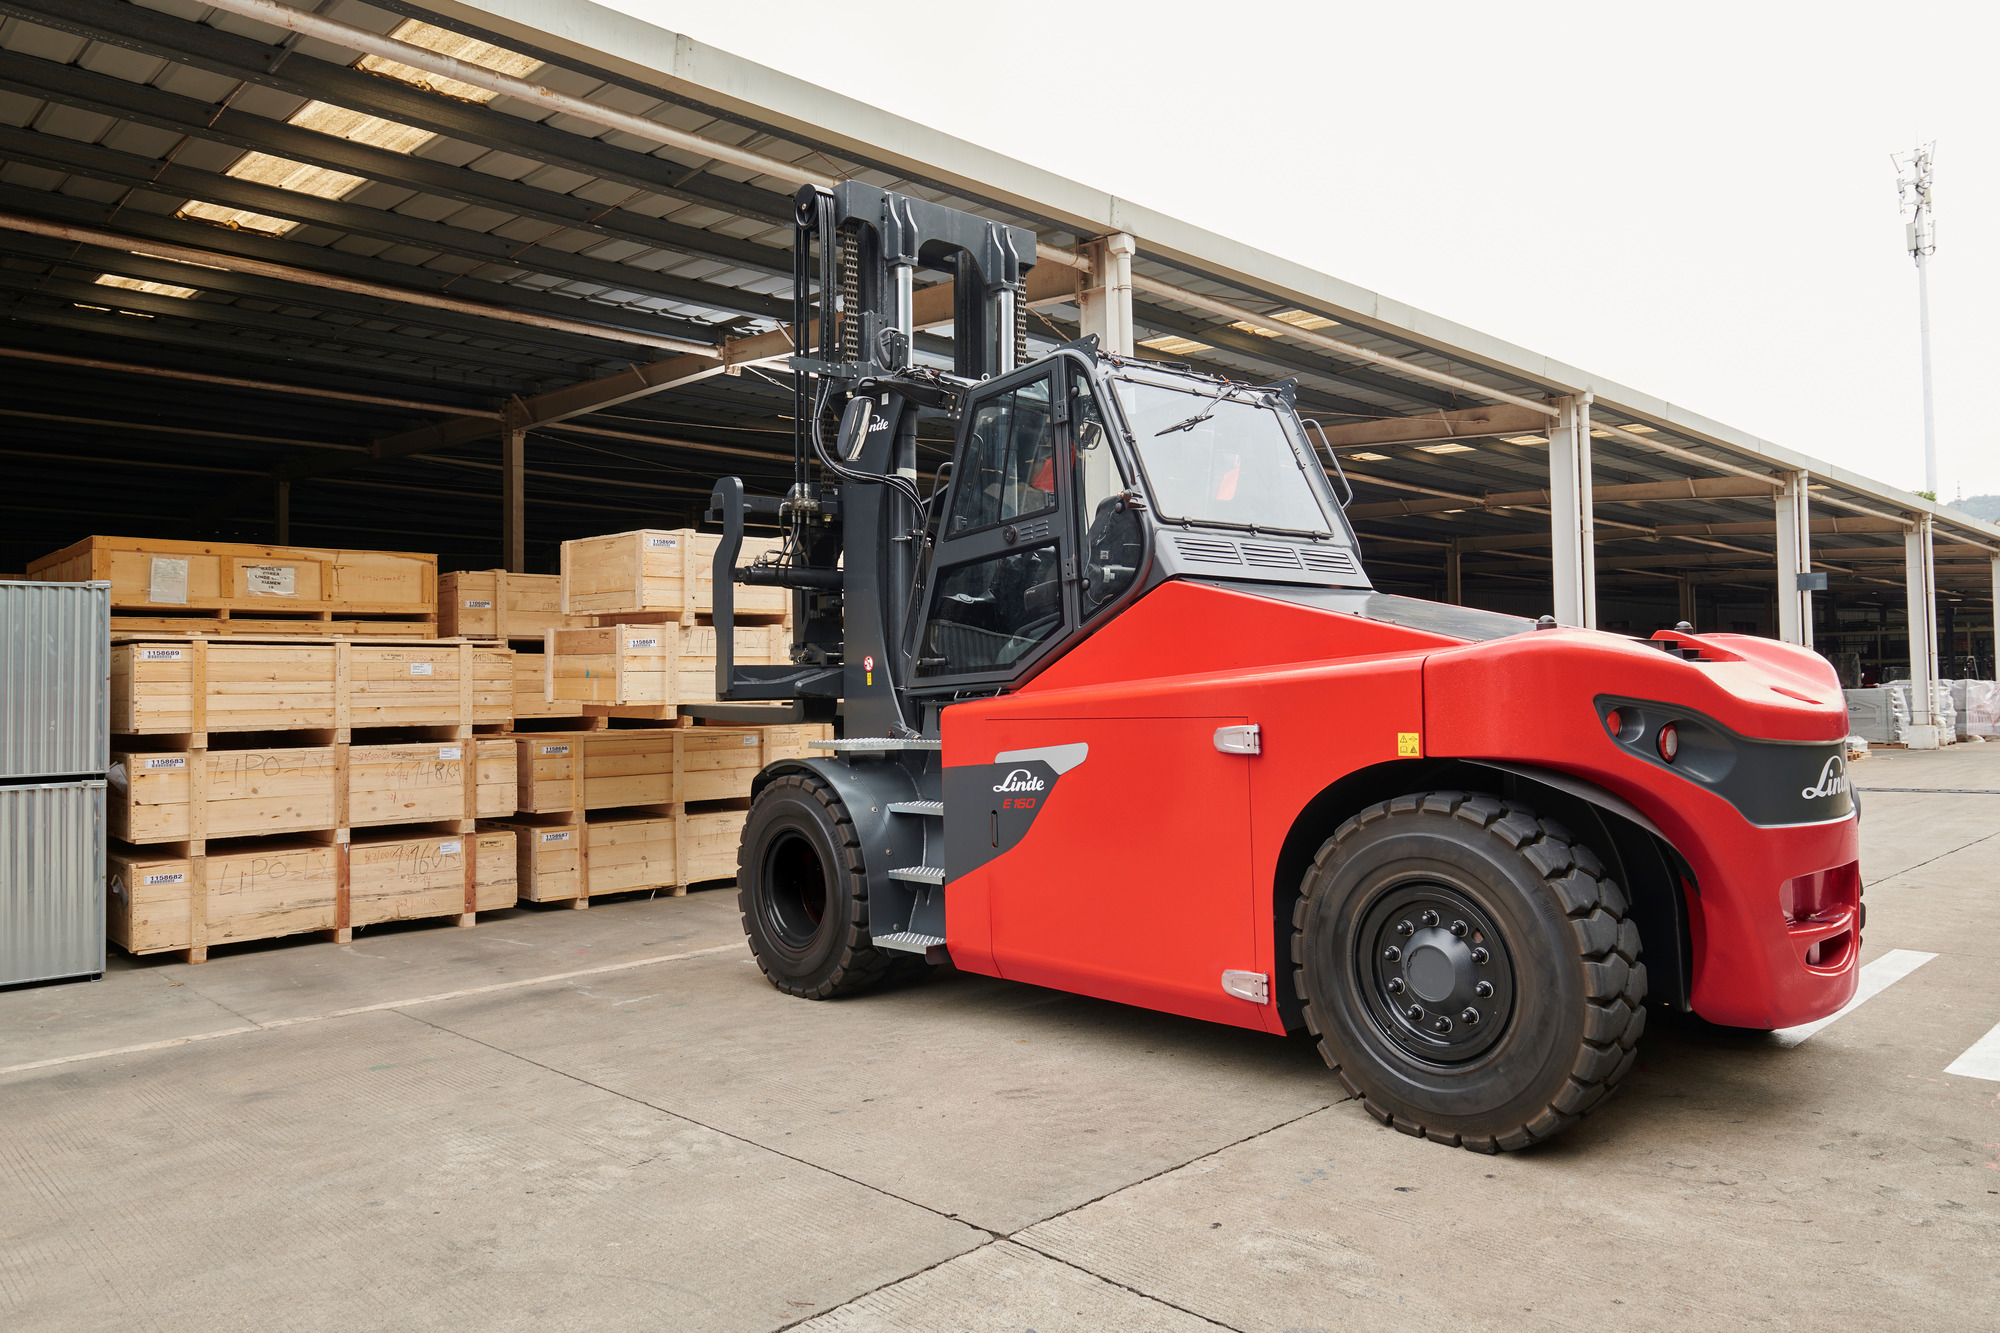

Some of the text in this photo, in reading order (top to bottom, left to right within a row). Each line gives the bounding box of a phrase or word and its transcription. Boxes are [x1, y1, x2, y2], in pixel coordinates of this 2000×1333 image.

[992, 768, 1045, 793] Linde
[1002, 798, 1036, 809] E 160
[149, 873, 184, 881] 1158682
